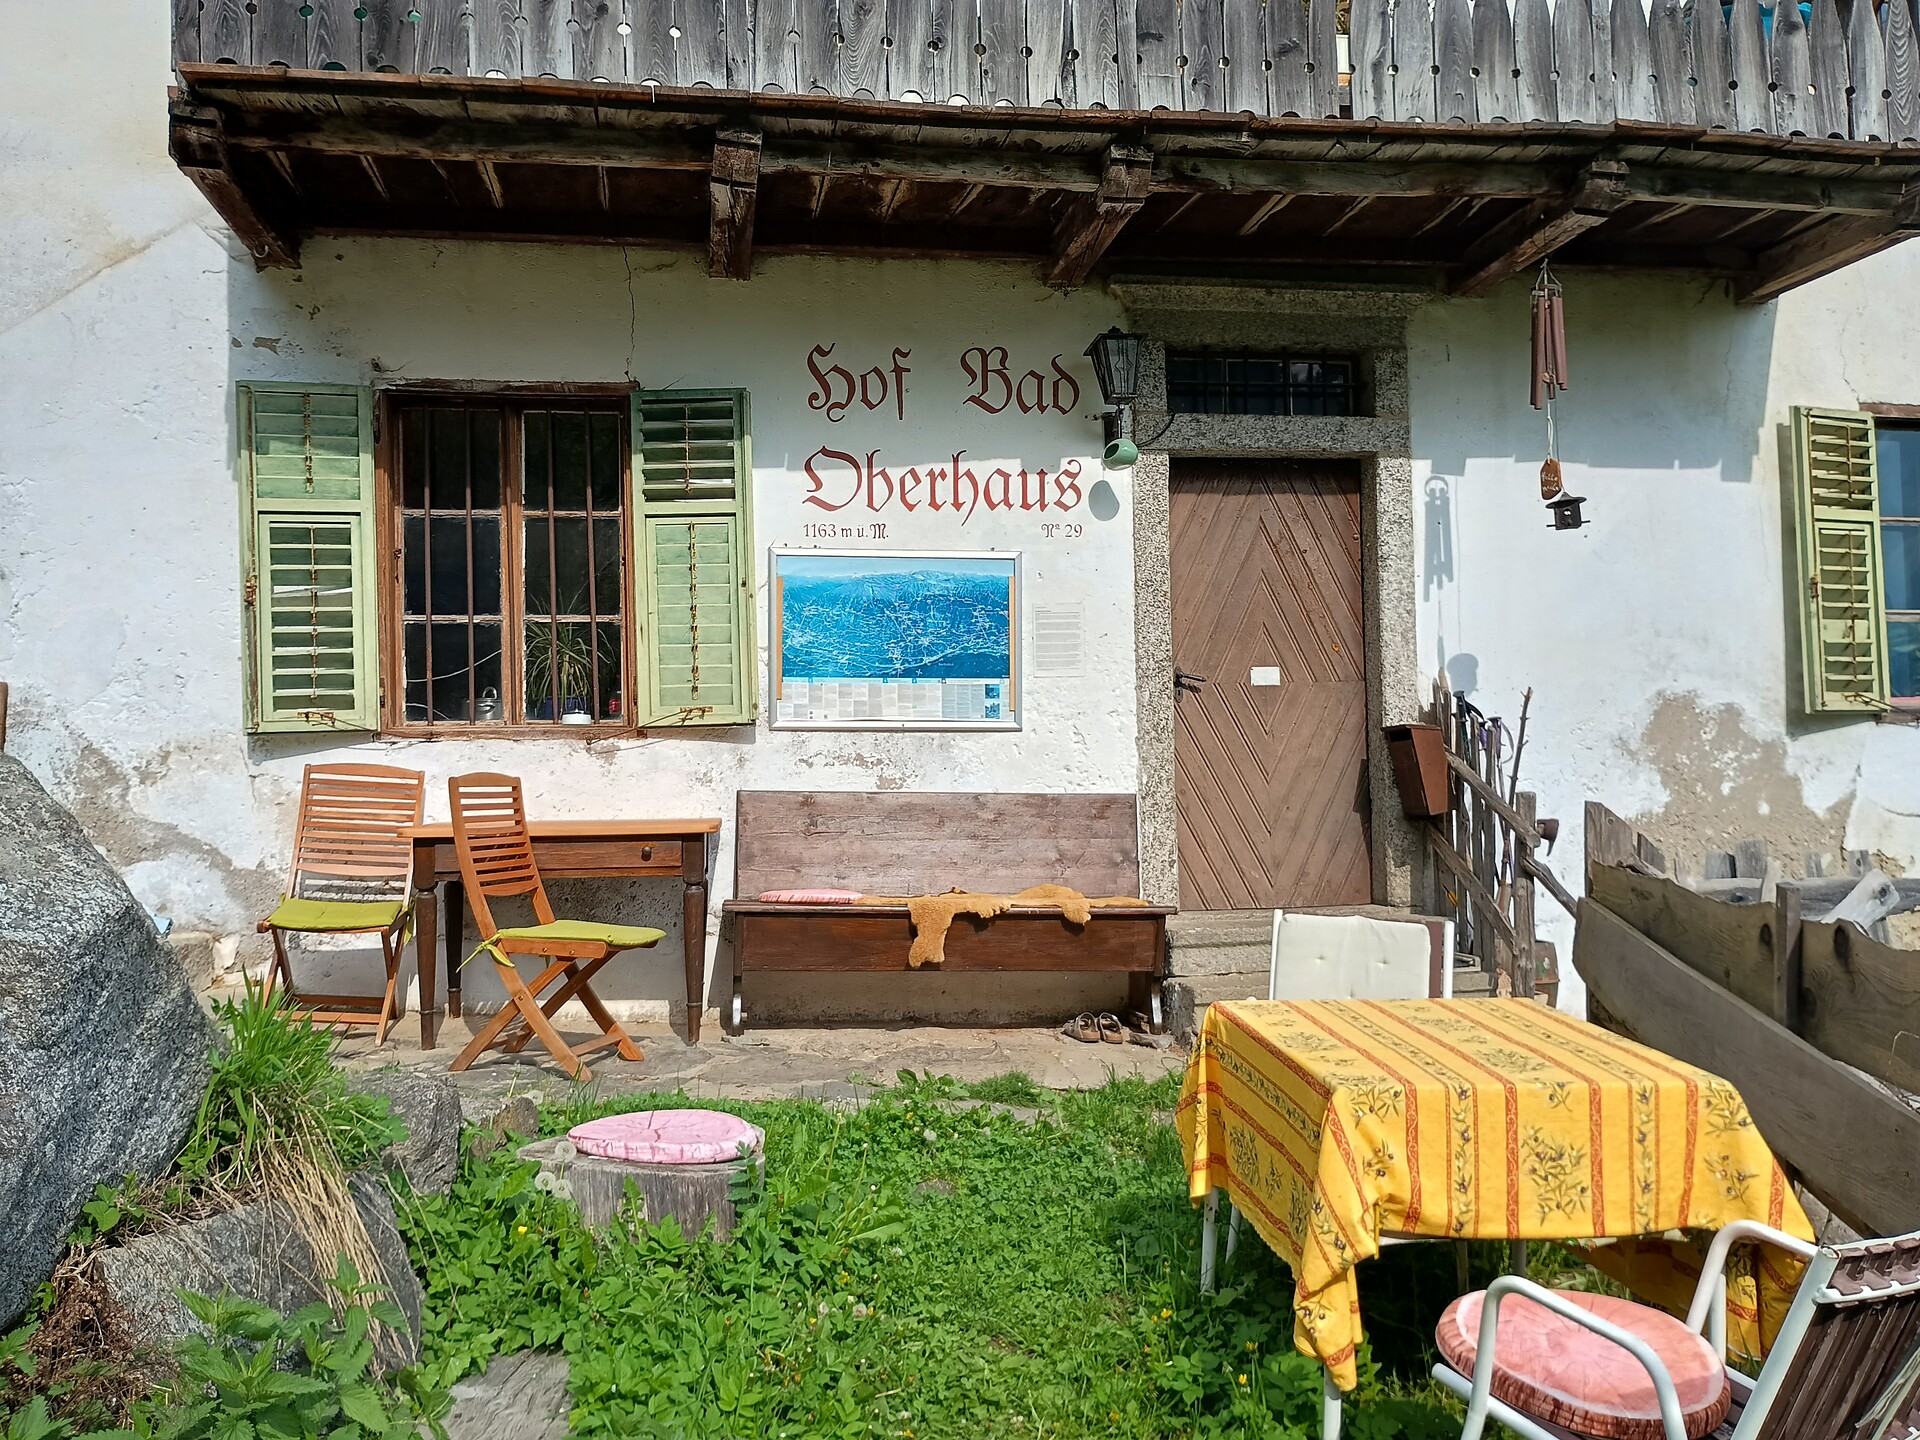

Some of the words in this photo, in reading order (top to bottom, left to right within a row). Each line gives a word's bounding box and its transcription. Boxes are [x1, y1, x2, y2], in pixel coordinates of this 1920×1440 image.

[806, 342, 913, 423] Hof
[959, 346, 1081, 416] Bad
[802, 445, 1083, 527] Oberhaus
[803, 523, 837, 539] 1163
[841, 528, 853, 538] m
[1064, 523, 1083, 538] 29
